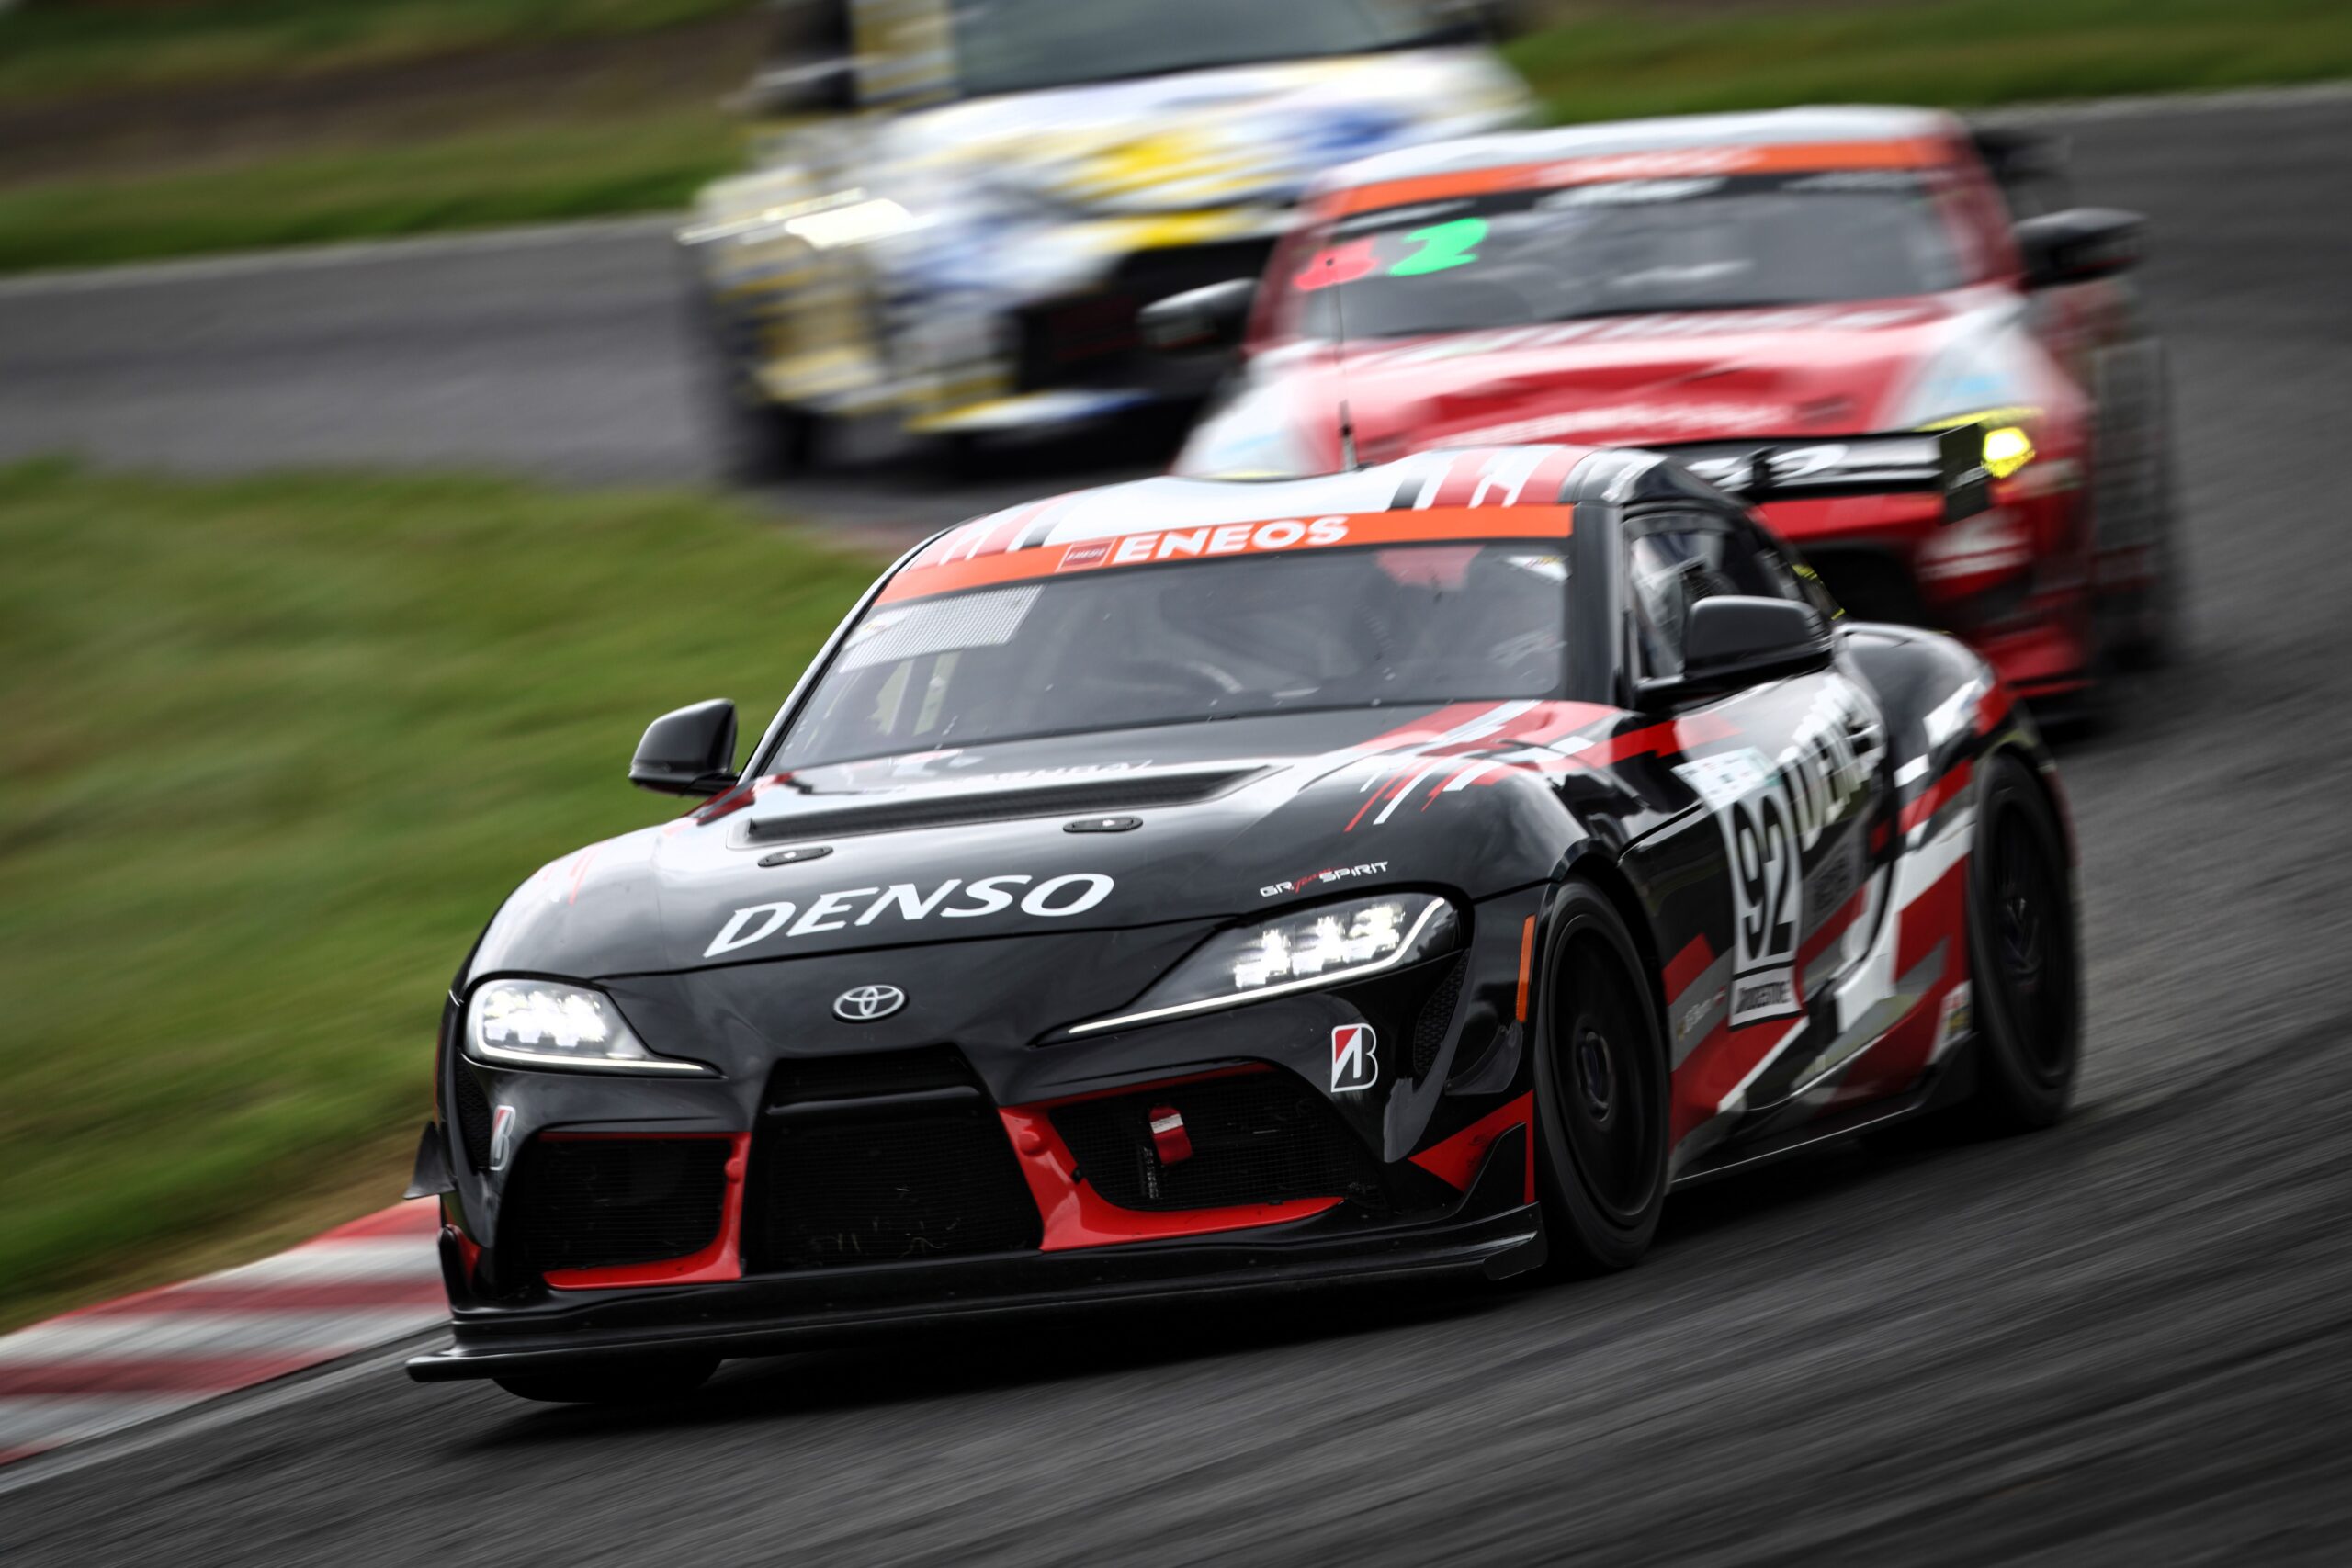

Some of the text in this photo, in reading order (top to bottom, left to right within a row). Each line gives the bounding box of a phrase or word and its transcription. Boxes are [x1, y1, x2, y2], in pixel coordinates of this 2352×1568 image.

[1112, 515, 1350, 565] ENEOS
[1260, 881, 1295, 897] GR
[1319, 861, 1388, 883] SPIRIT
[1732, 794, 1796, 962] 92
[702, 873, 1115, 958] DENSO
